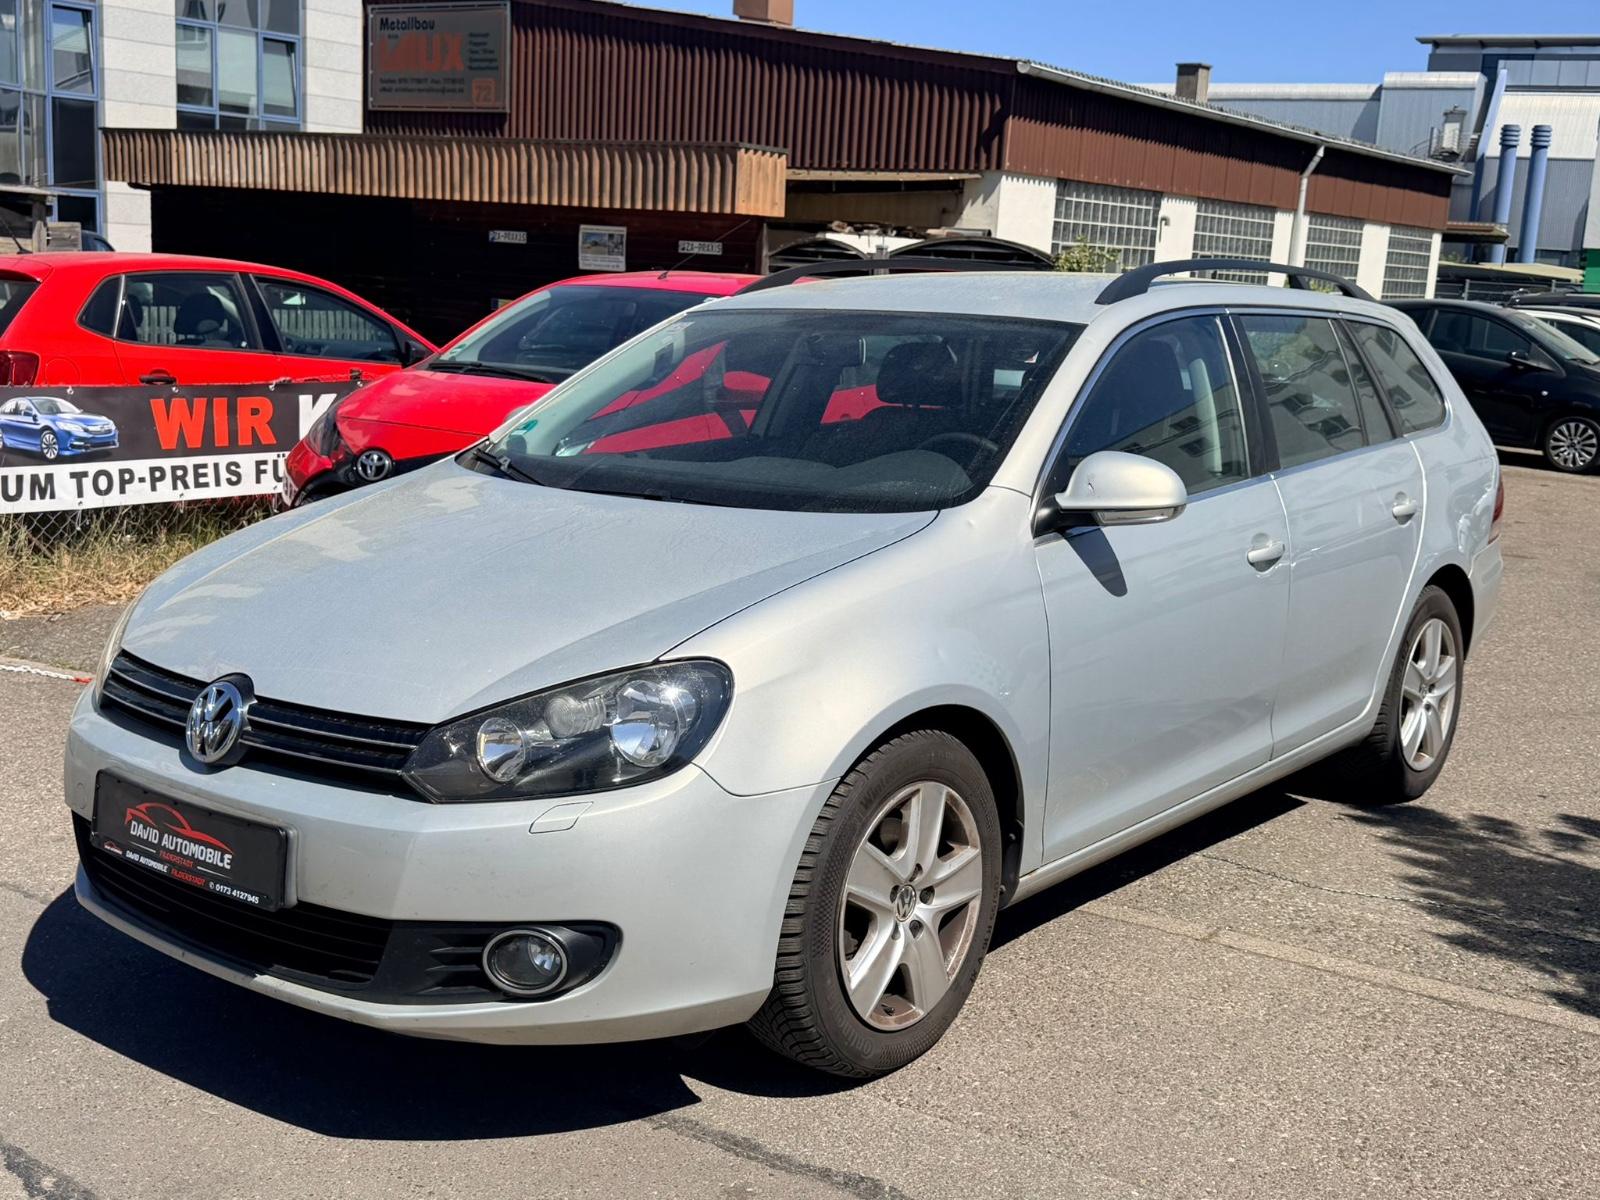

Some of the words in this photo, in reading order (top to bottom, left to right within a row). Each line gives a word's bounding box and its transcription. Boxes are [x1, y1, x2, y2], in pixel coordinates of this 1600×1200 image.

[380, 16, 435, 31] Metallbau
[150, 396, 277, 450] WIR
[1, 473, 56, 502] UM
[70, 460, 243, 499] TOP-PREIS
[130, 820, 159, 844] DAVID
[161, 833, 232, 870] AUTOMOBILE
[125, 850, 140, 862] DAVID
[139, 855, 168, 873] AUTOMOBILE
[215, 884, 231, 896] 0173
[232, 889, 260, 904] 4127945
